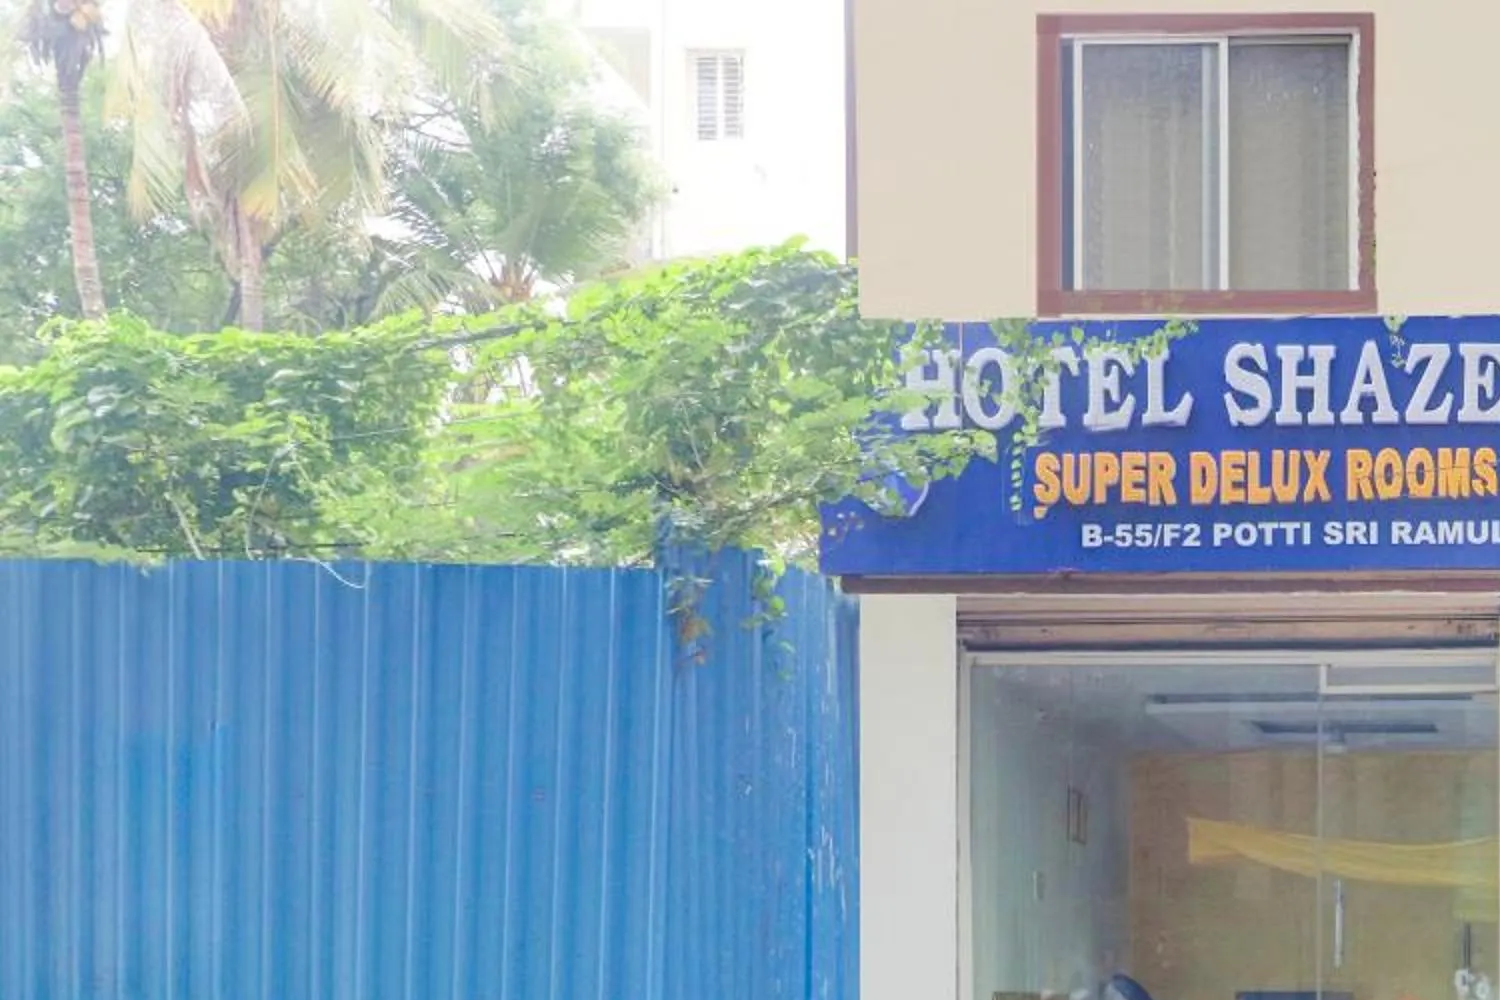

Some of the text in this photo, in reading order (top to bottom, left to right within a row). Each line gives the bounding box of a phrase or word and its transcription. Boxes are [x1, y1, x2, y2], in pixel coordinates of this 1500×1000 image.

[901, 347, 1194, 431] HOTEL
[1034, 451, 1176, 507] SUPER
[1189, 450, 1330, 505] DELUX
[1346, 447, 1498, 500] ROOMS
[1081, 523, 1202, 548] B-55/F2
[1213, 521, 1312, 547] POTTI
[1323, 520, 1379, 546] SRI
